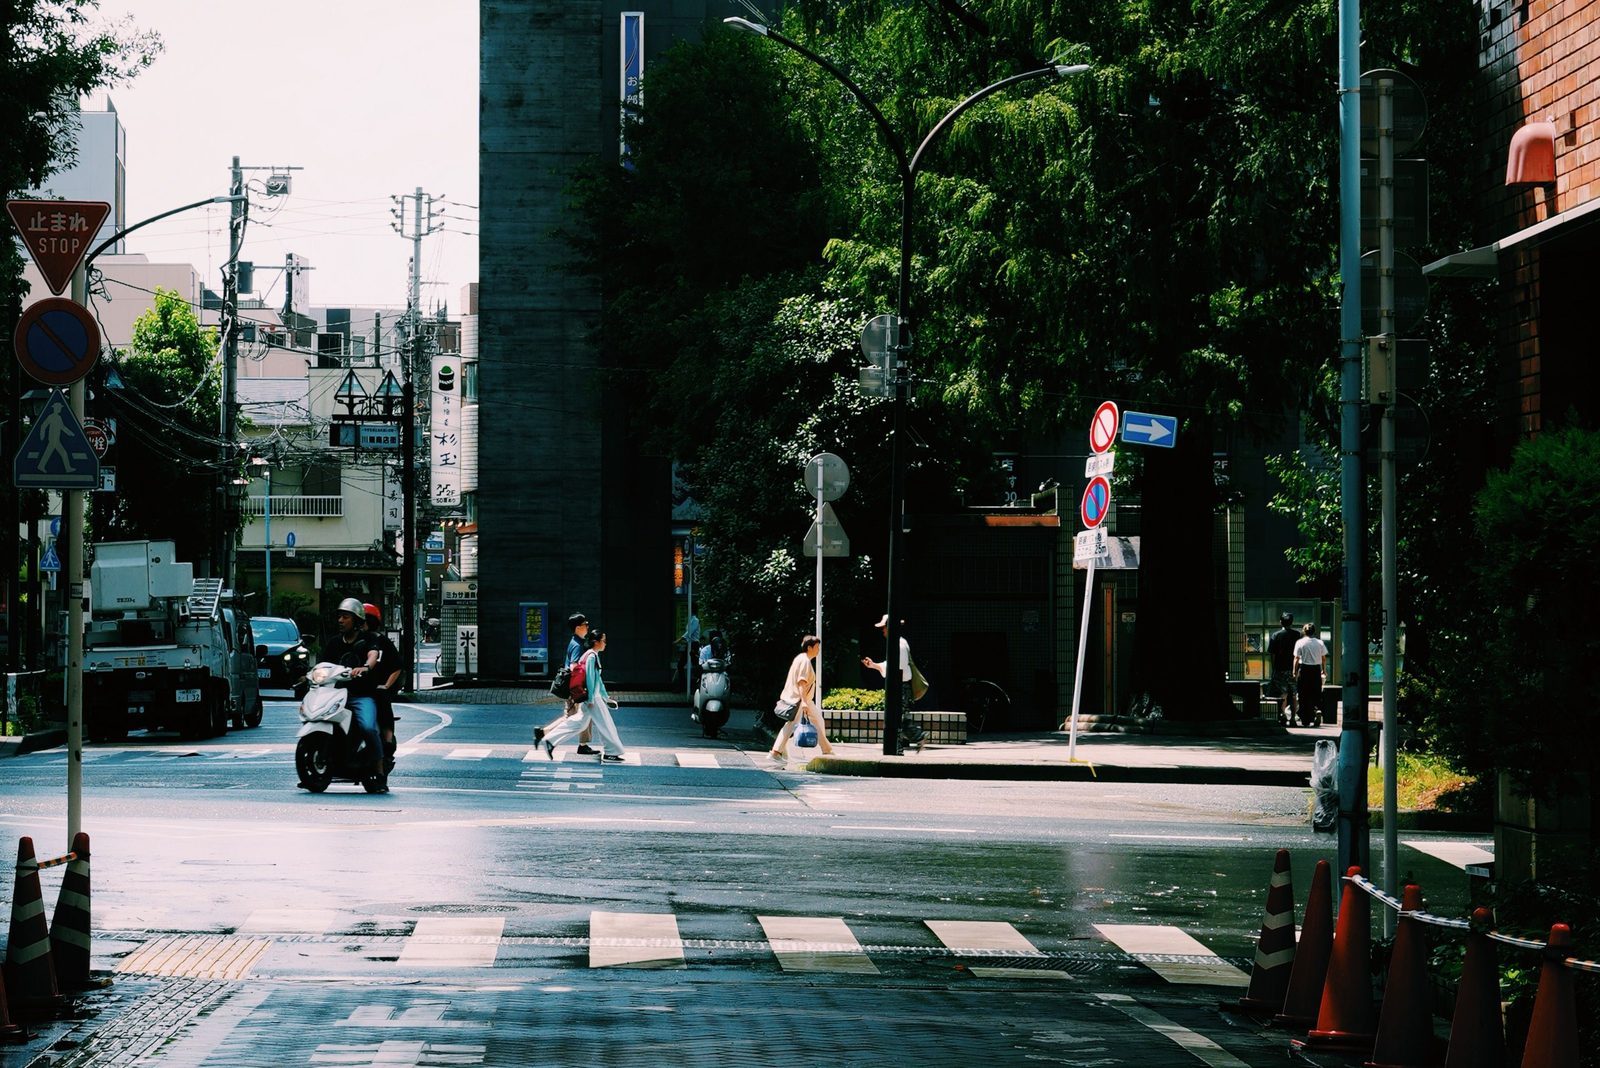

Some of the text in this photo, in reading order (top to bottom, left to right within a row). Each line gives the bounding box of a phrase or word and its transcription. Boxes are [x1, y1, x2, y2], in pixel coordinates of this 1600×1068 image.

[28, 212, 89, 232] 止まれ
[39, 237, 80, 254] STOP
[434, 432, 457, 466] 杉玉
